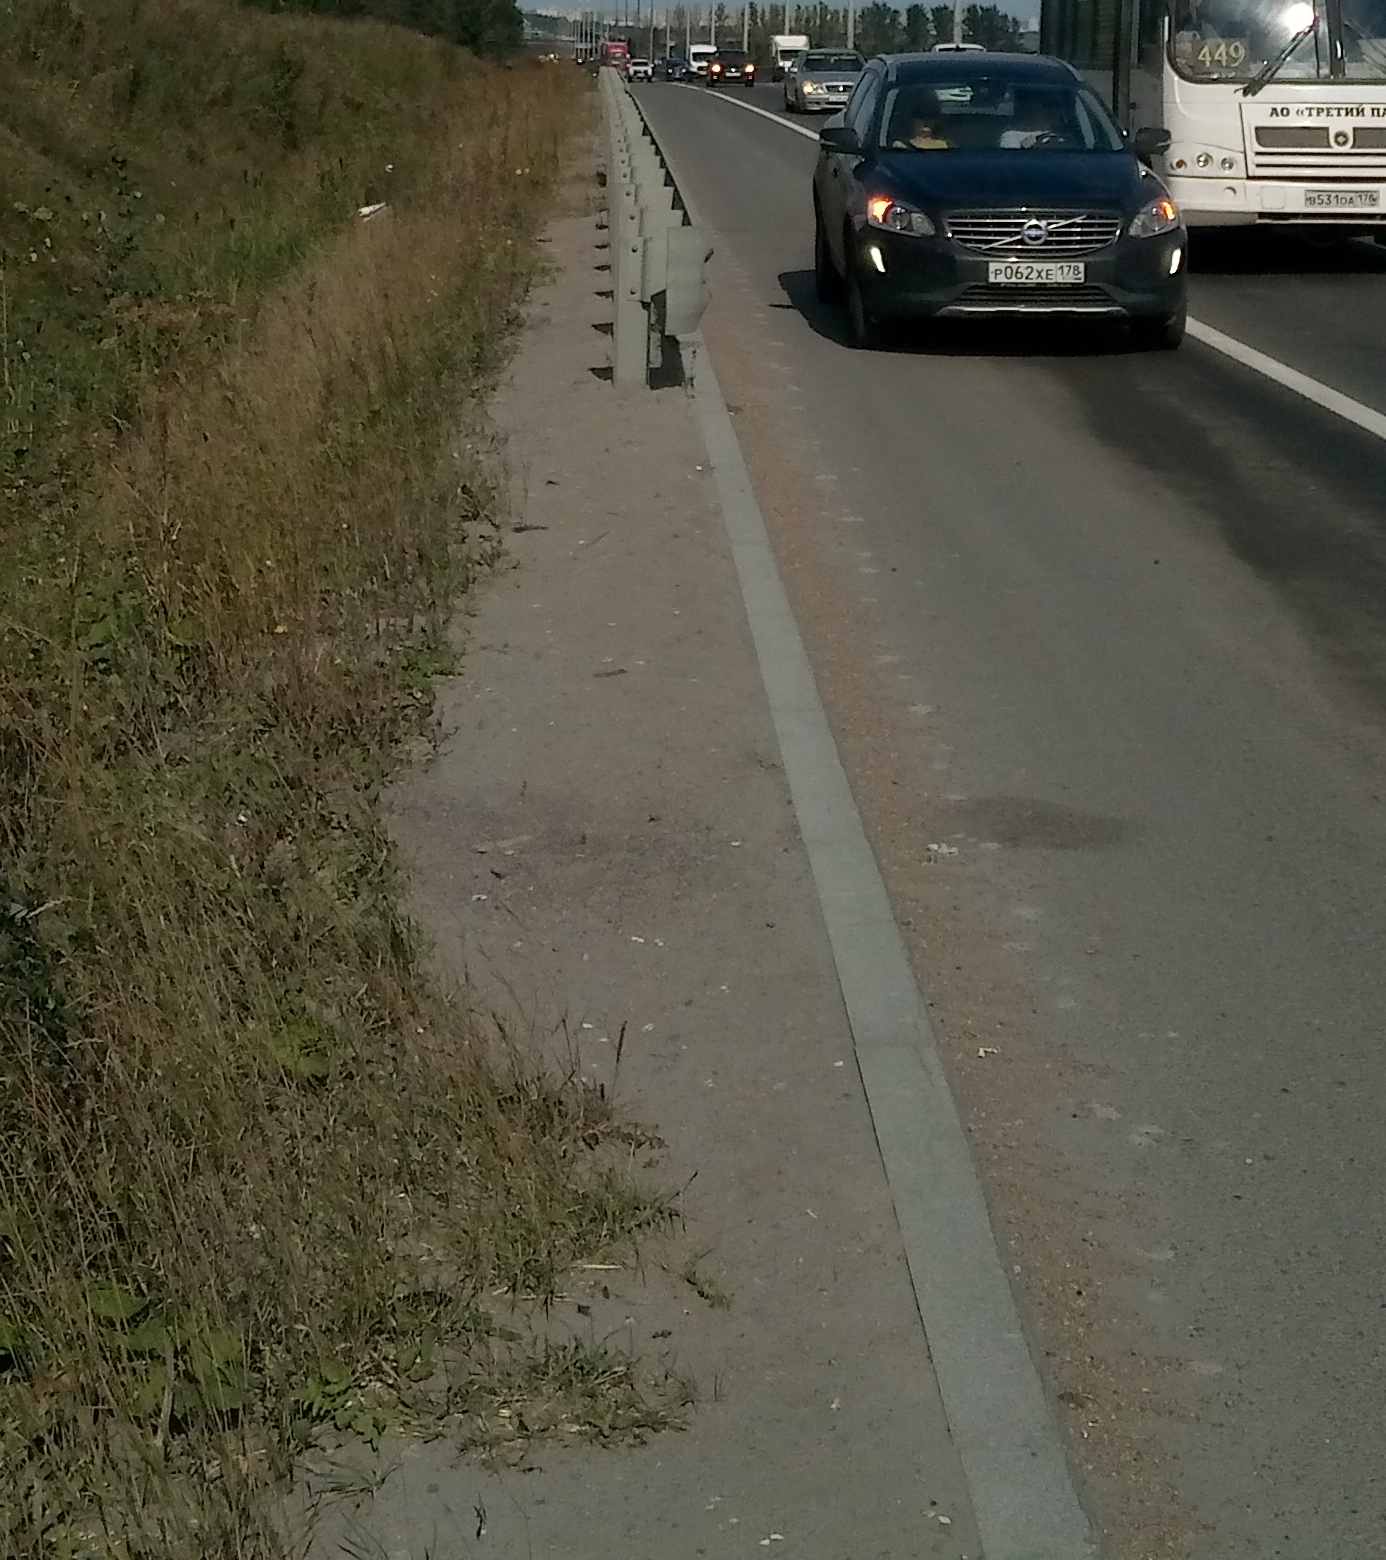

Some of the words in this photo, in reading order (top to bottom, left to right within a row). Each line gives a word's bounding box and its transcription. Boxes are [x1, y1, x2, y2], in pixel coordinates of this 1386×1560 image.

[1197, 41, 1246, 68] 449
[1269, 107, 1290, 117] АО
[1295, 105, 1365, 117] «ТРЕТИЙ
[1057, 264, 1081, 276] 178
